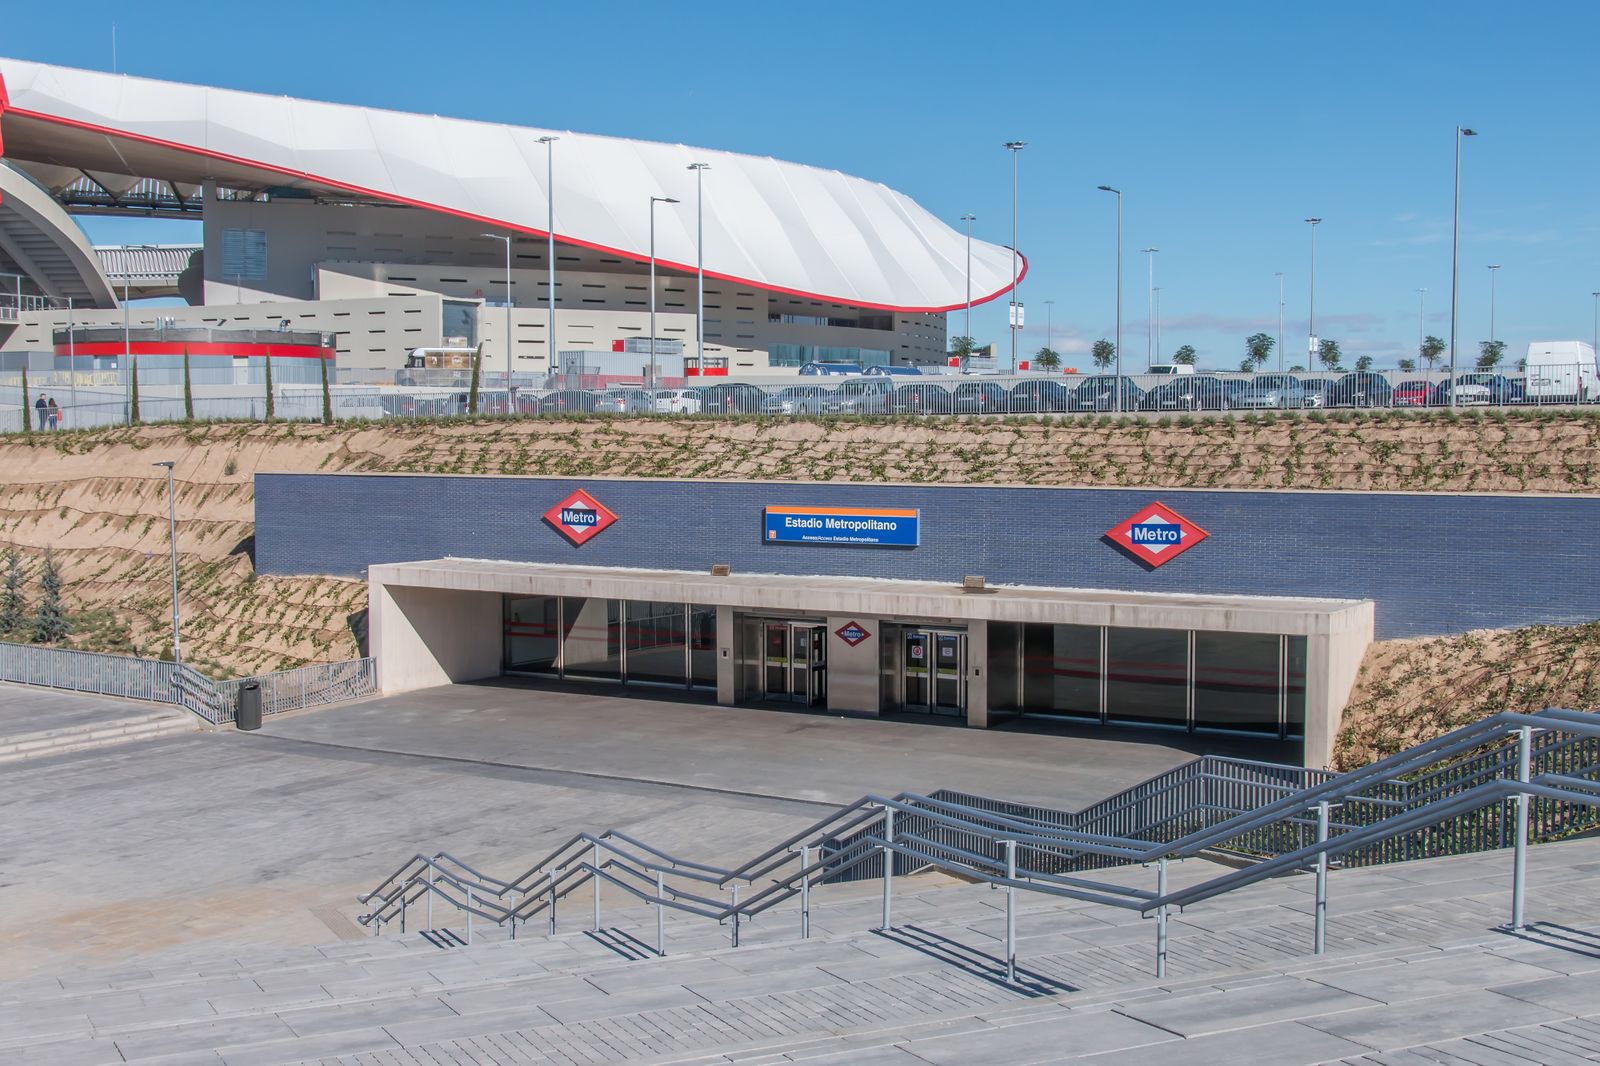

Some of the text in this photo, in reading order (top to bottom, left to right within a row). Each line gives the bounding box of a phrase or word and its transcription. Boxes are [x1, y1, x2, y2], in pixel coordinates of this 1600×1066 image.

[563, 511, 595, 523] Metro
[785, 517, 897, 532] Estadio Metropolitano
[1134, 527, 1178, 541] Metro
[844, 630, 861, 638] Metro
